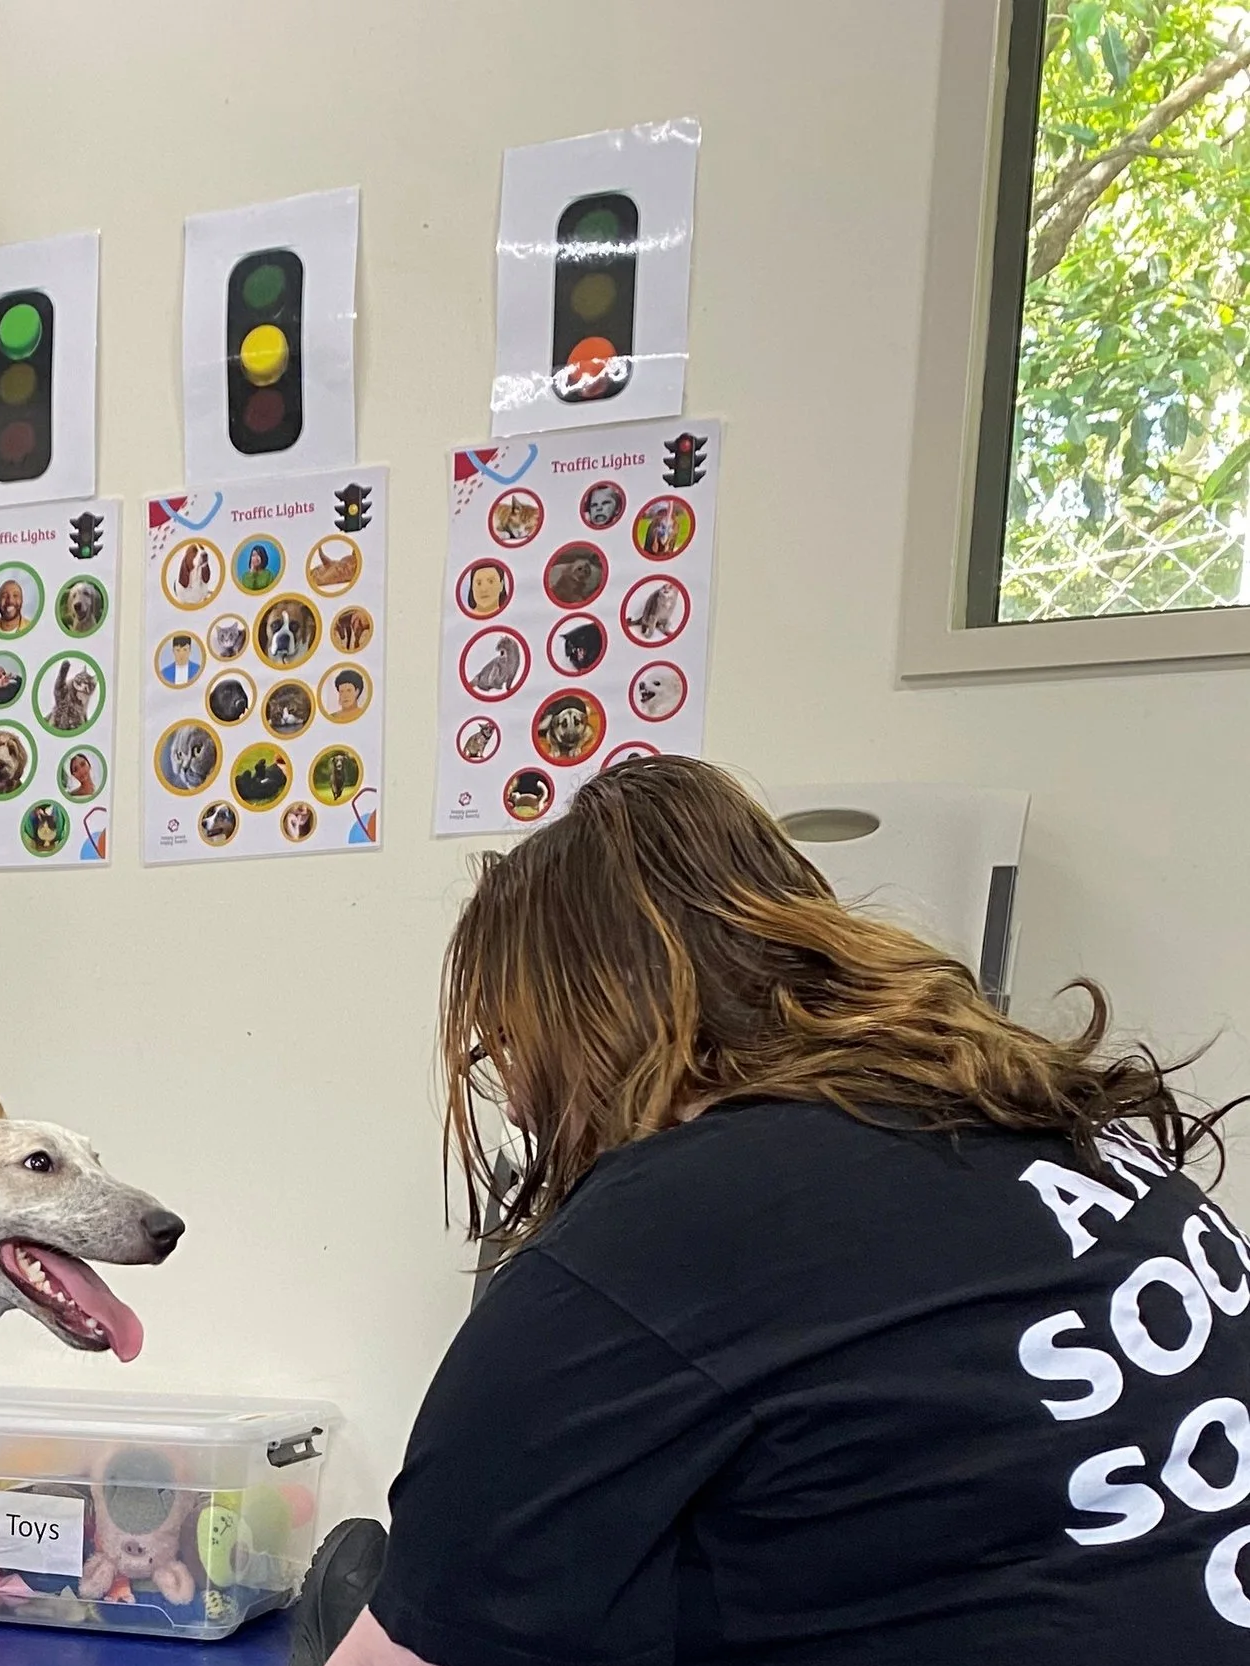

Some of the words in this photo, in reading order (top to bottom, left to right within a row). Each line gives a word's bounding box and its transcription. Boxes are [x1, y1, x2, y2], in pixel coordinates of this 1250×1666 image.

[550, 456, 598, 473] Traffic
[601, 452, 645, 470] Lights
[231, 506, 273, 522] Traffic
[275, 502, 315, 518] Lights
[21, 528, 56, 544] Lights
[6, 1513, 59, 1544] Toys
